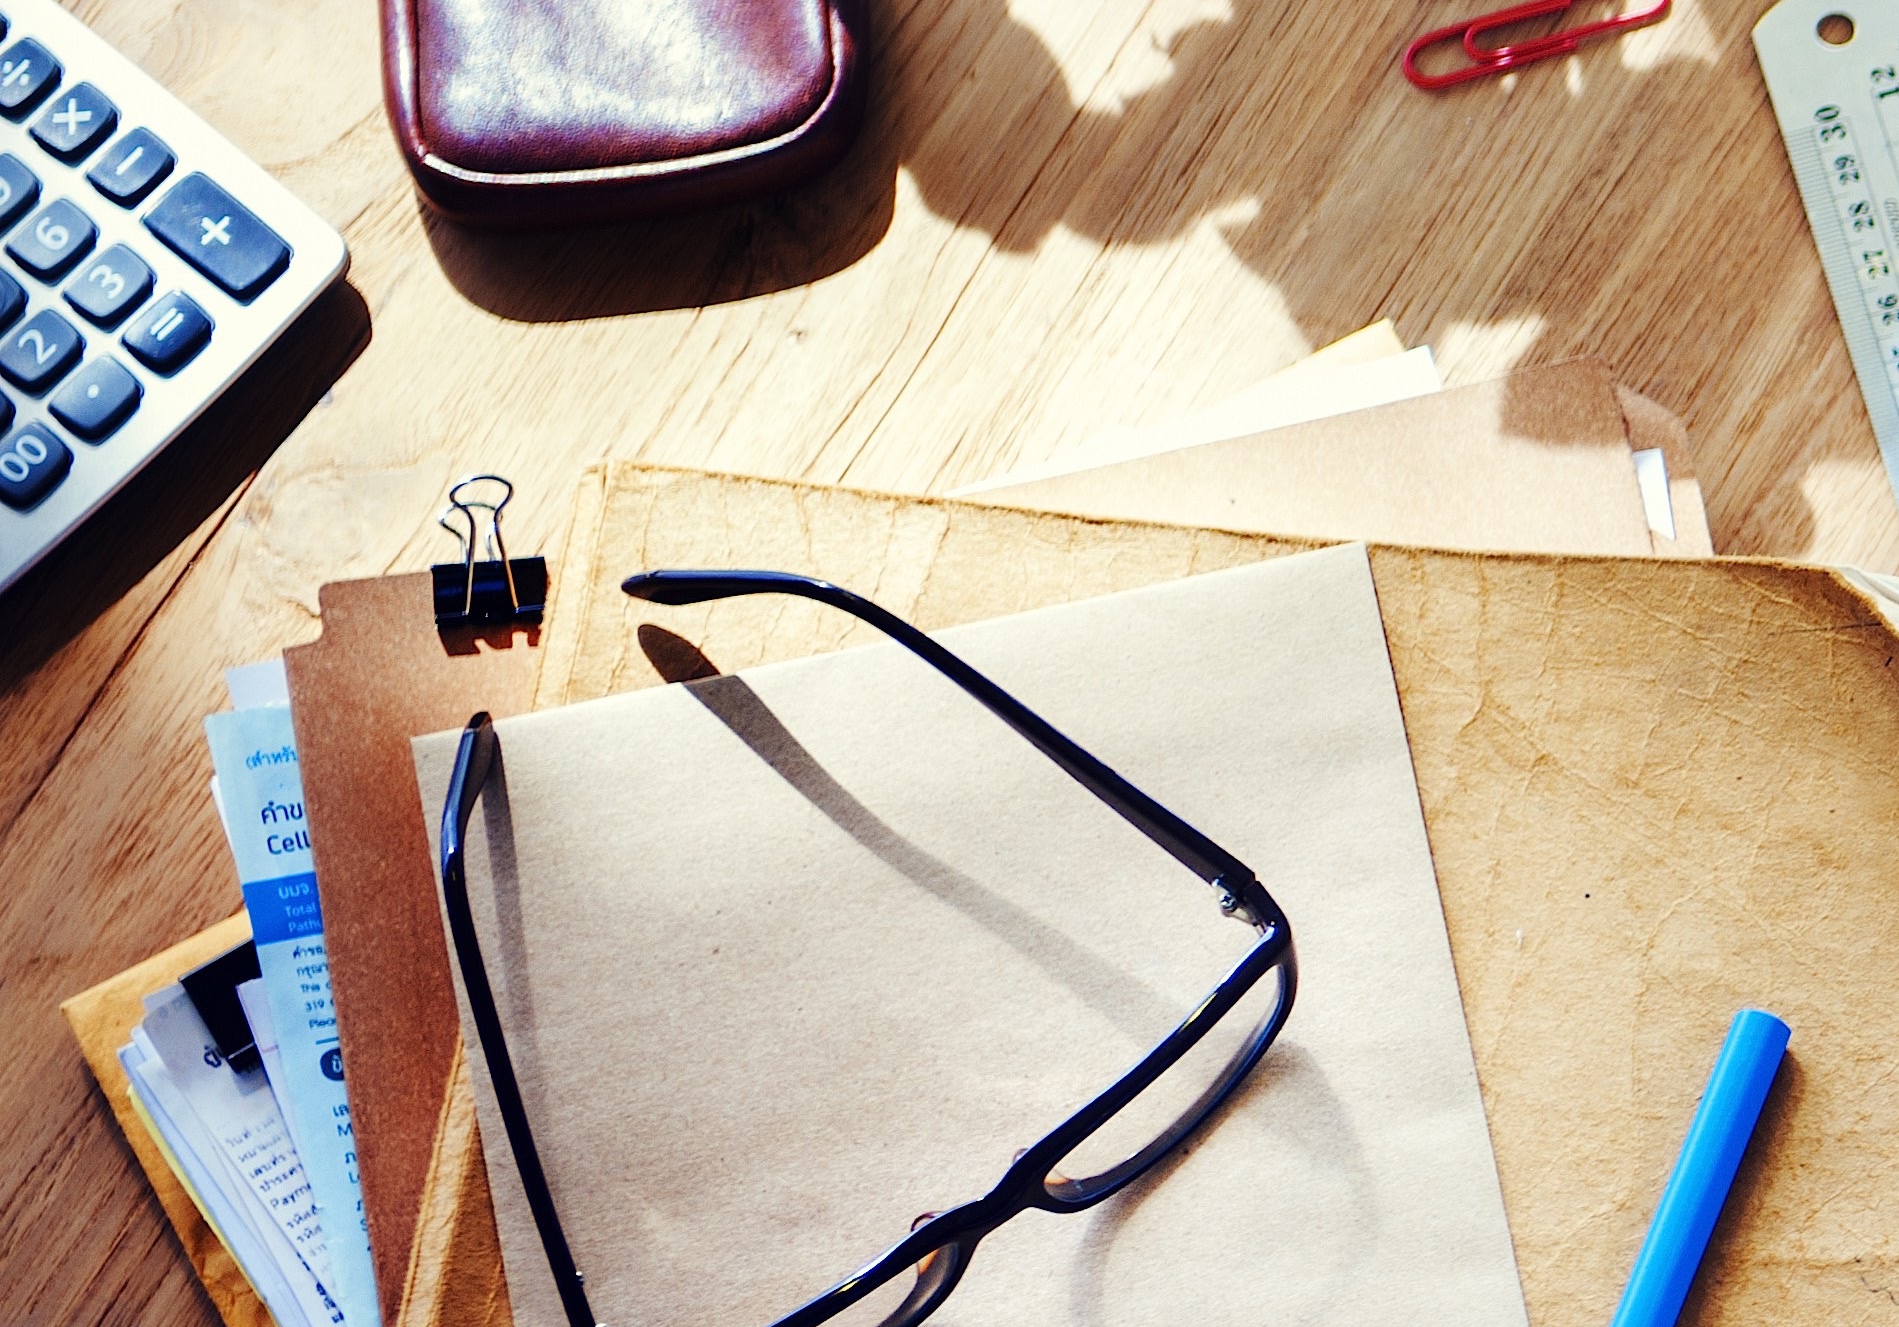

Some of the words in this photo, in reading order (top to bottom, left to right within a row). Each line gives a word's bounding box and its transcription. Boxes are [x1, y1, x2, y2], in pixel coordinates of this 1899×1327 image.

[1814, 104, 1848, 139] 30
[1833, 155, 1860, 185] 29
[1846, 201, 1874, 230] 28
[35, 216, 69, 250] 6
[1862, 249, 1890, 279] 27
[87, 263, 125, 300] 3
[17, 328, 58, 366] 2
